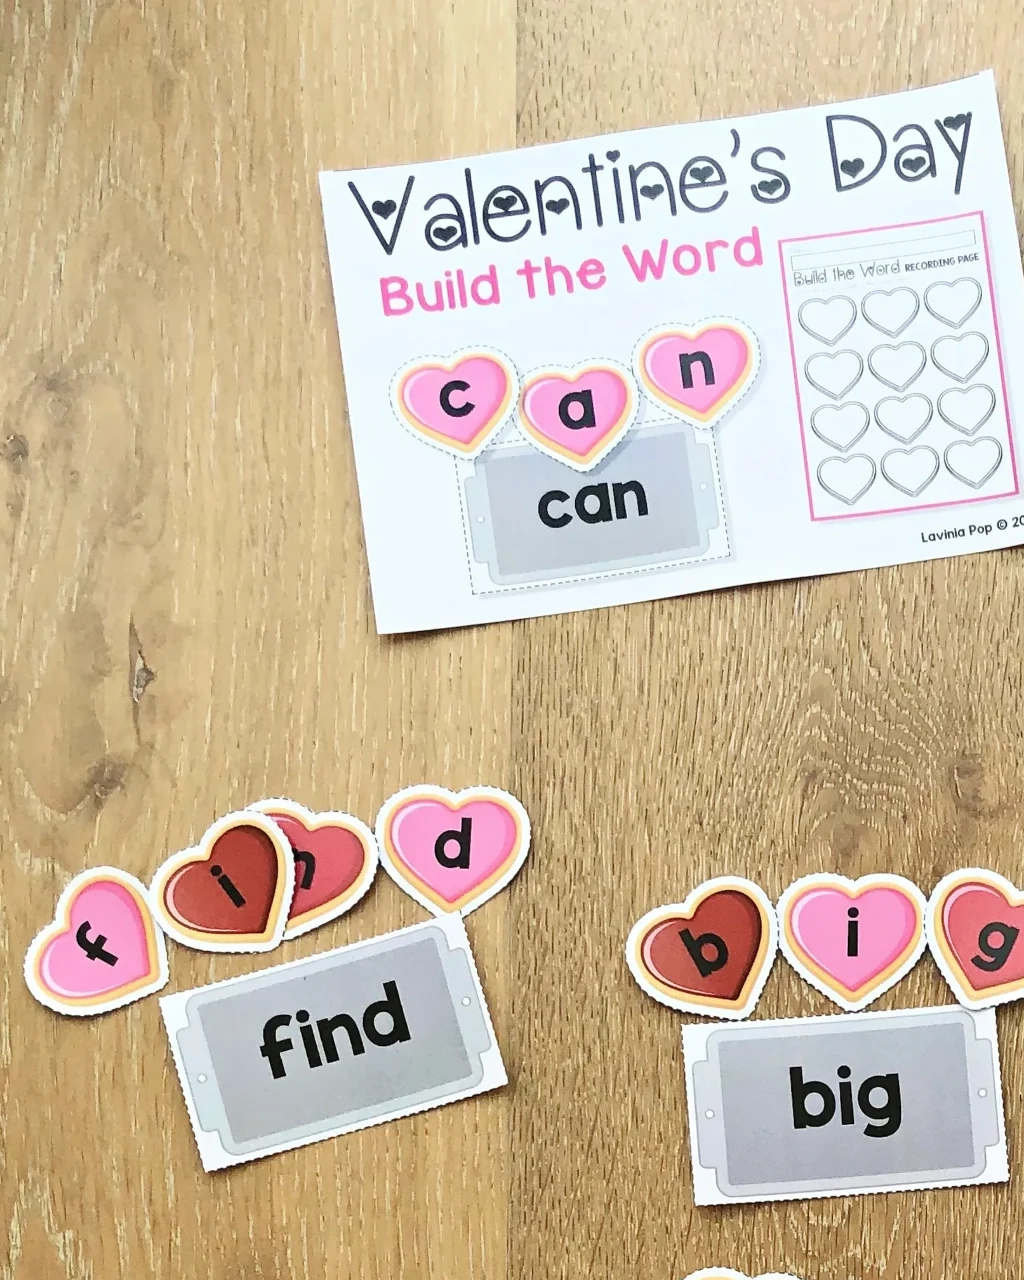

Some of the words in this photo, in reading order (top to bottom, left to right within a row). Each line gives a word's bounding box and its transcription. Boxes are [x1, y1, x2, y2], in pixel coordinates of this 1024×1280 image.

[348, 128, 790, 255] Valentine's
[826, 112, 972, 196] Day
[380, 264, 500, 317] Build
[517, 252, 607, 301] the
[622, 227, 764, 283] Word
[793, 269, 827, 287] Build
[833, 266, 855, 281] the
[859, 259, 900, 277] Word
[904, 257, 956, 273] RECORDING
[957, 252, 980, 266] PAGE
[439, 379, 475, 418] c
[558, 389, 596, 430] a
[679, 345, 715, 390] n
[537, 476, 649, 529] can
[921, 527, 965, 543] Lavinia
[969, 523, 992, 536] Pop
[76, 920, 118, 967] f
[210, 865, 246, 908] i
[434, 817, 472, 869] d
[678, 928, 729, 978] b
[847, 906, 859, 957] i
[970, 921, 1020, 972] g
[259, 980, 412, 1080] find
[789, 1065, 901, 1138] big
